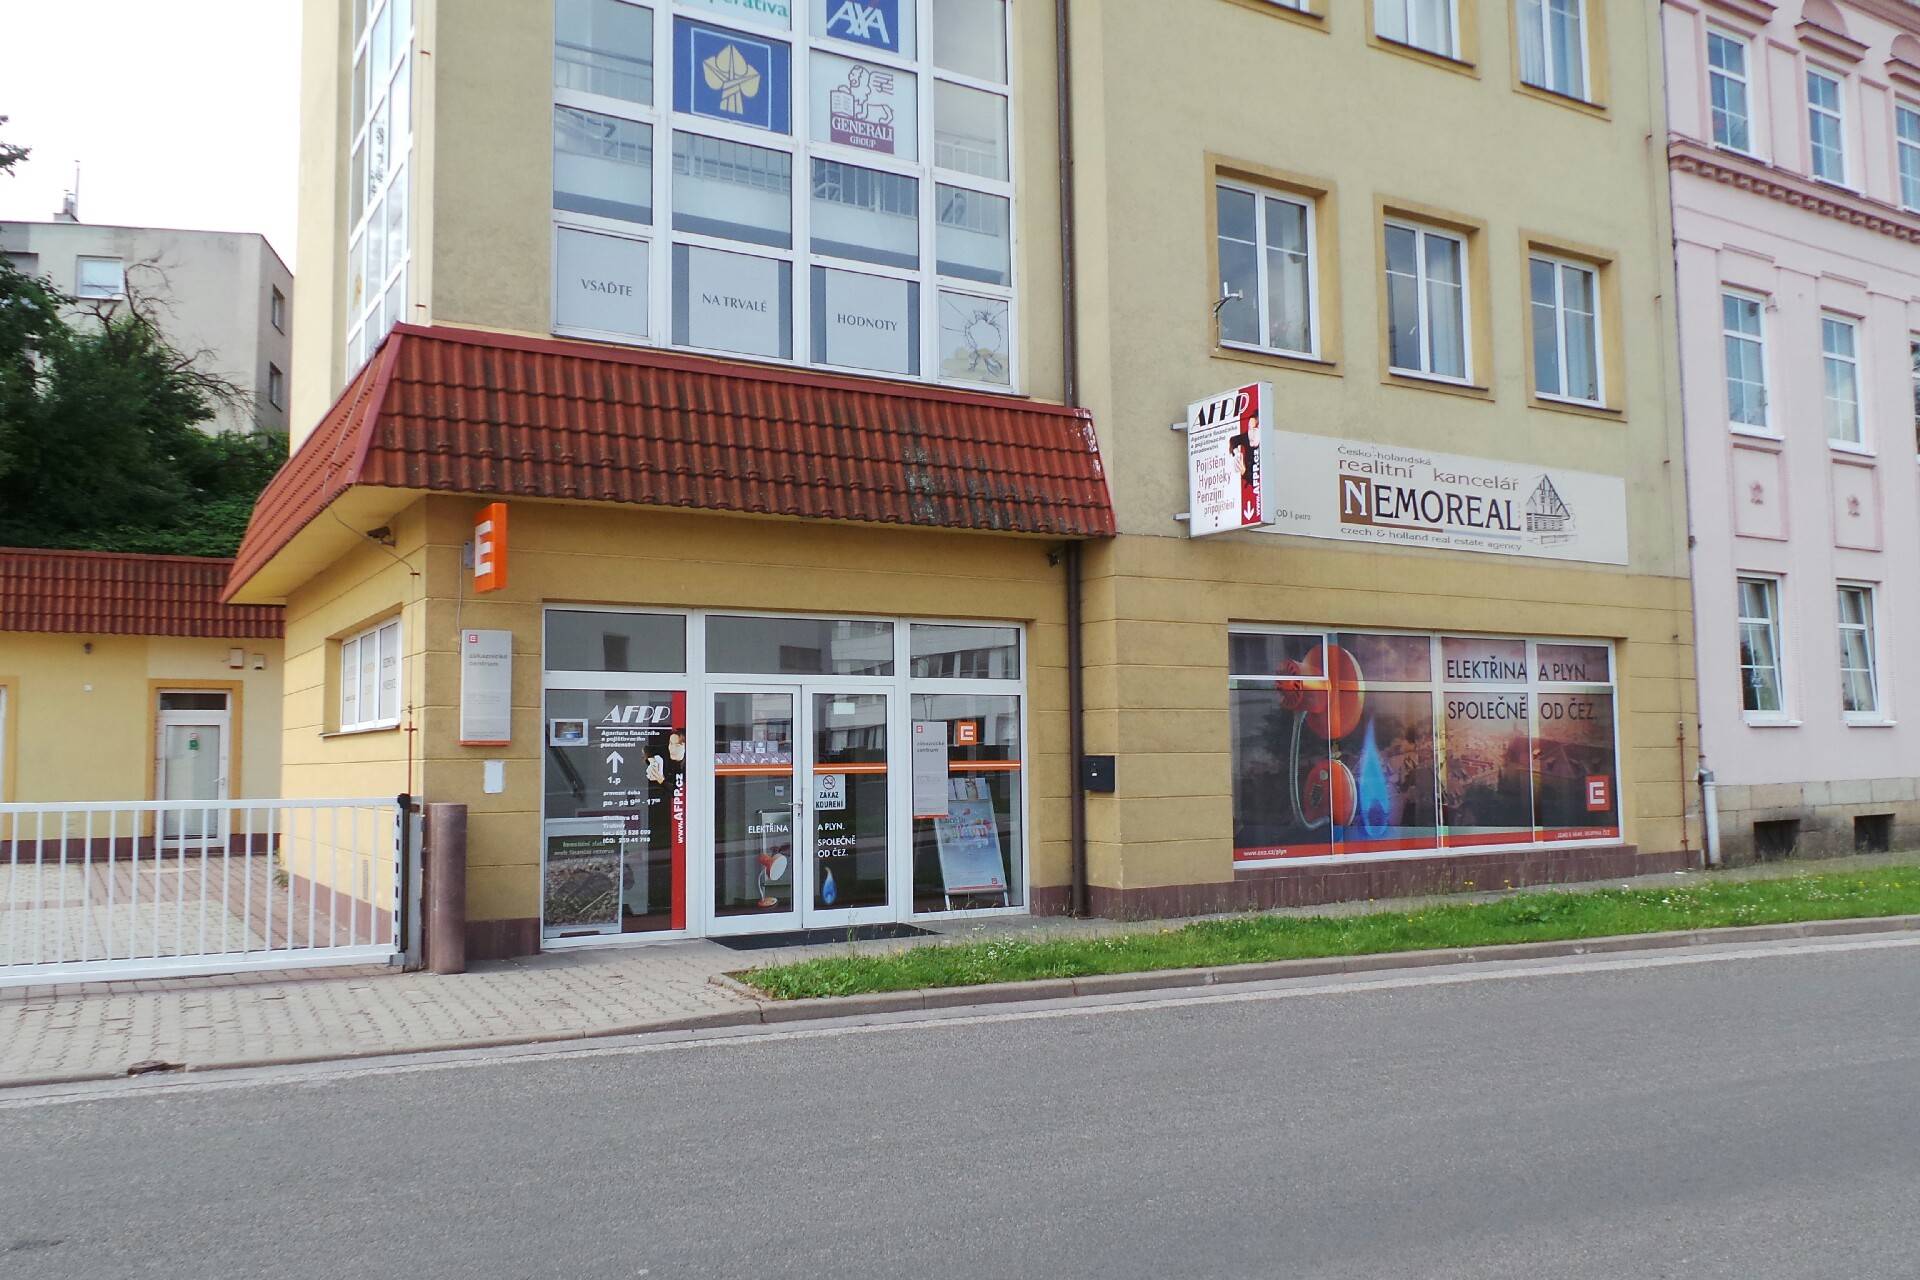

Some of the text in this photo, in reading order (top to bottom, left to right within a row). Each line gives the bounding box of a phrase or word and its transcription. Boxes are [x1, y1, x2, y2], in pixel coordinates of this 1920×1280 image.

[827, 0, 890, 44] AXA
[832, 117, 893, 141] GENERALI
[850, 136, 876, 148] GROUP
[581, 278, 898, 331] VSAĎTE NA TRVALÉ HODNOTY
[1191, 392, 1249, 430] AFPP
[1196, 453, 1226, 474] Pojištění
[1198, 468, 1231, 490] Hypotéky
[1252, 449, 1261, 517] www.AFPP.cz
[1339, 460, 1519, 491] realitní kancelář
[1196, 485, 1225, 504] Penzijní
[1344, 479, 1521, 531] NEMOREAL
[1204, 498, 1235, 516] připojištění
[1341, 527, 1522, 551] czech & holland real estate agency
[1447, 655, 1591, 681] ELEKTŘINA A PLYN.
[601, 705, 671, 723] AFPP
[1448, 696, 1528, 719] SPOLEČNĚ
[1540, 702, 1564, 720] OD
[607, 776, 622, 785] 1.p
[819, 790, 839, 799] ZÁKAZ
[673, 773, 684, 844] www.AFPP.cz
[748, 823, 789, 834] ELEKTŘINA
[825, 822, 846, 831] PLYN.
[817, 835, 856, 847] SPOLEČNĚ
[817, 850, 831, 858] OD
